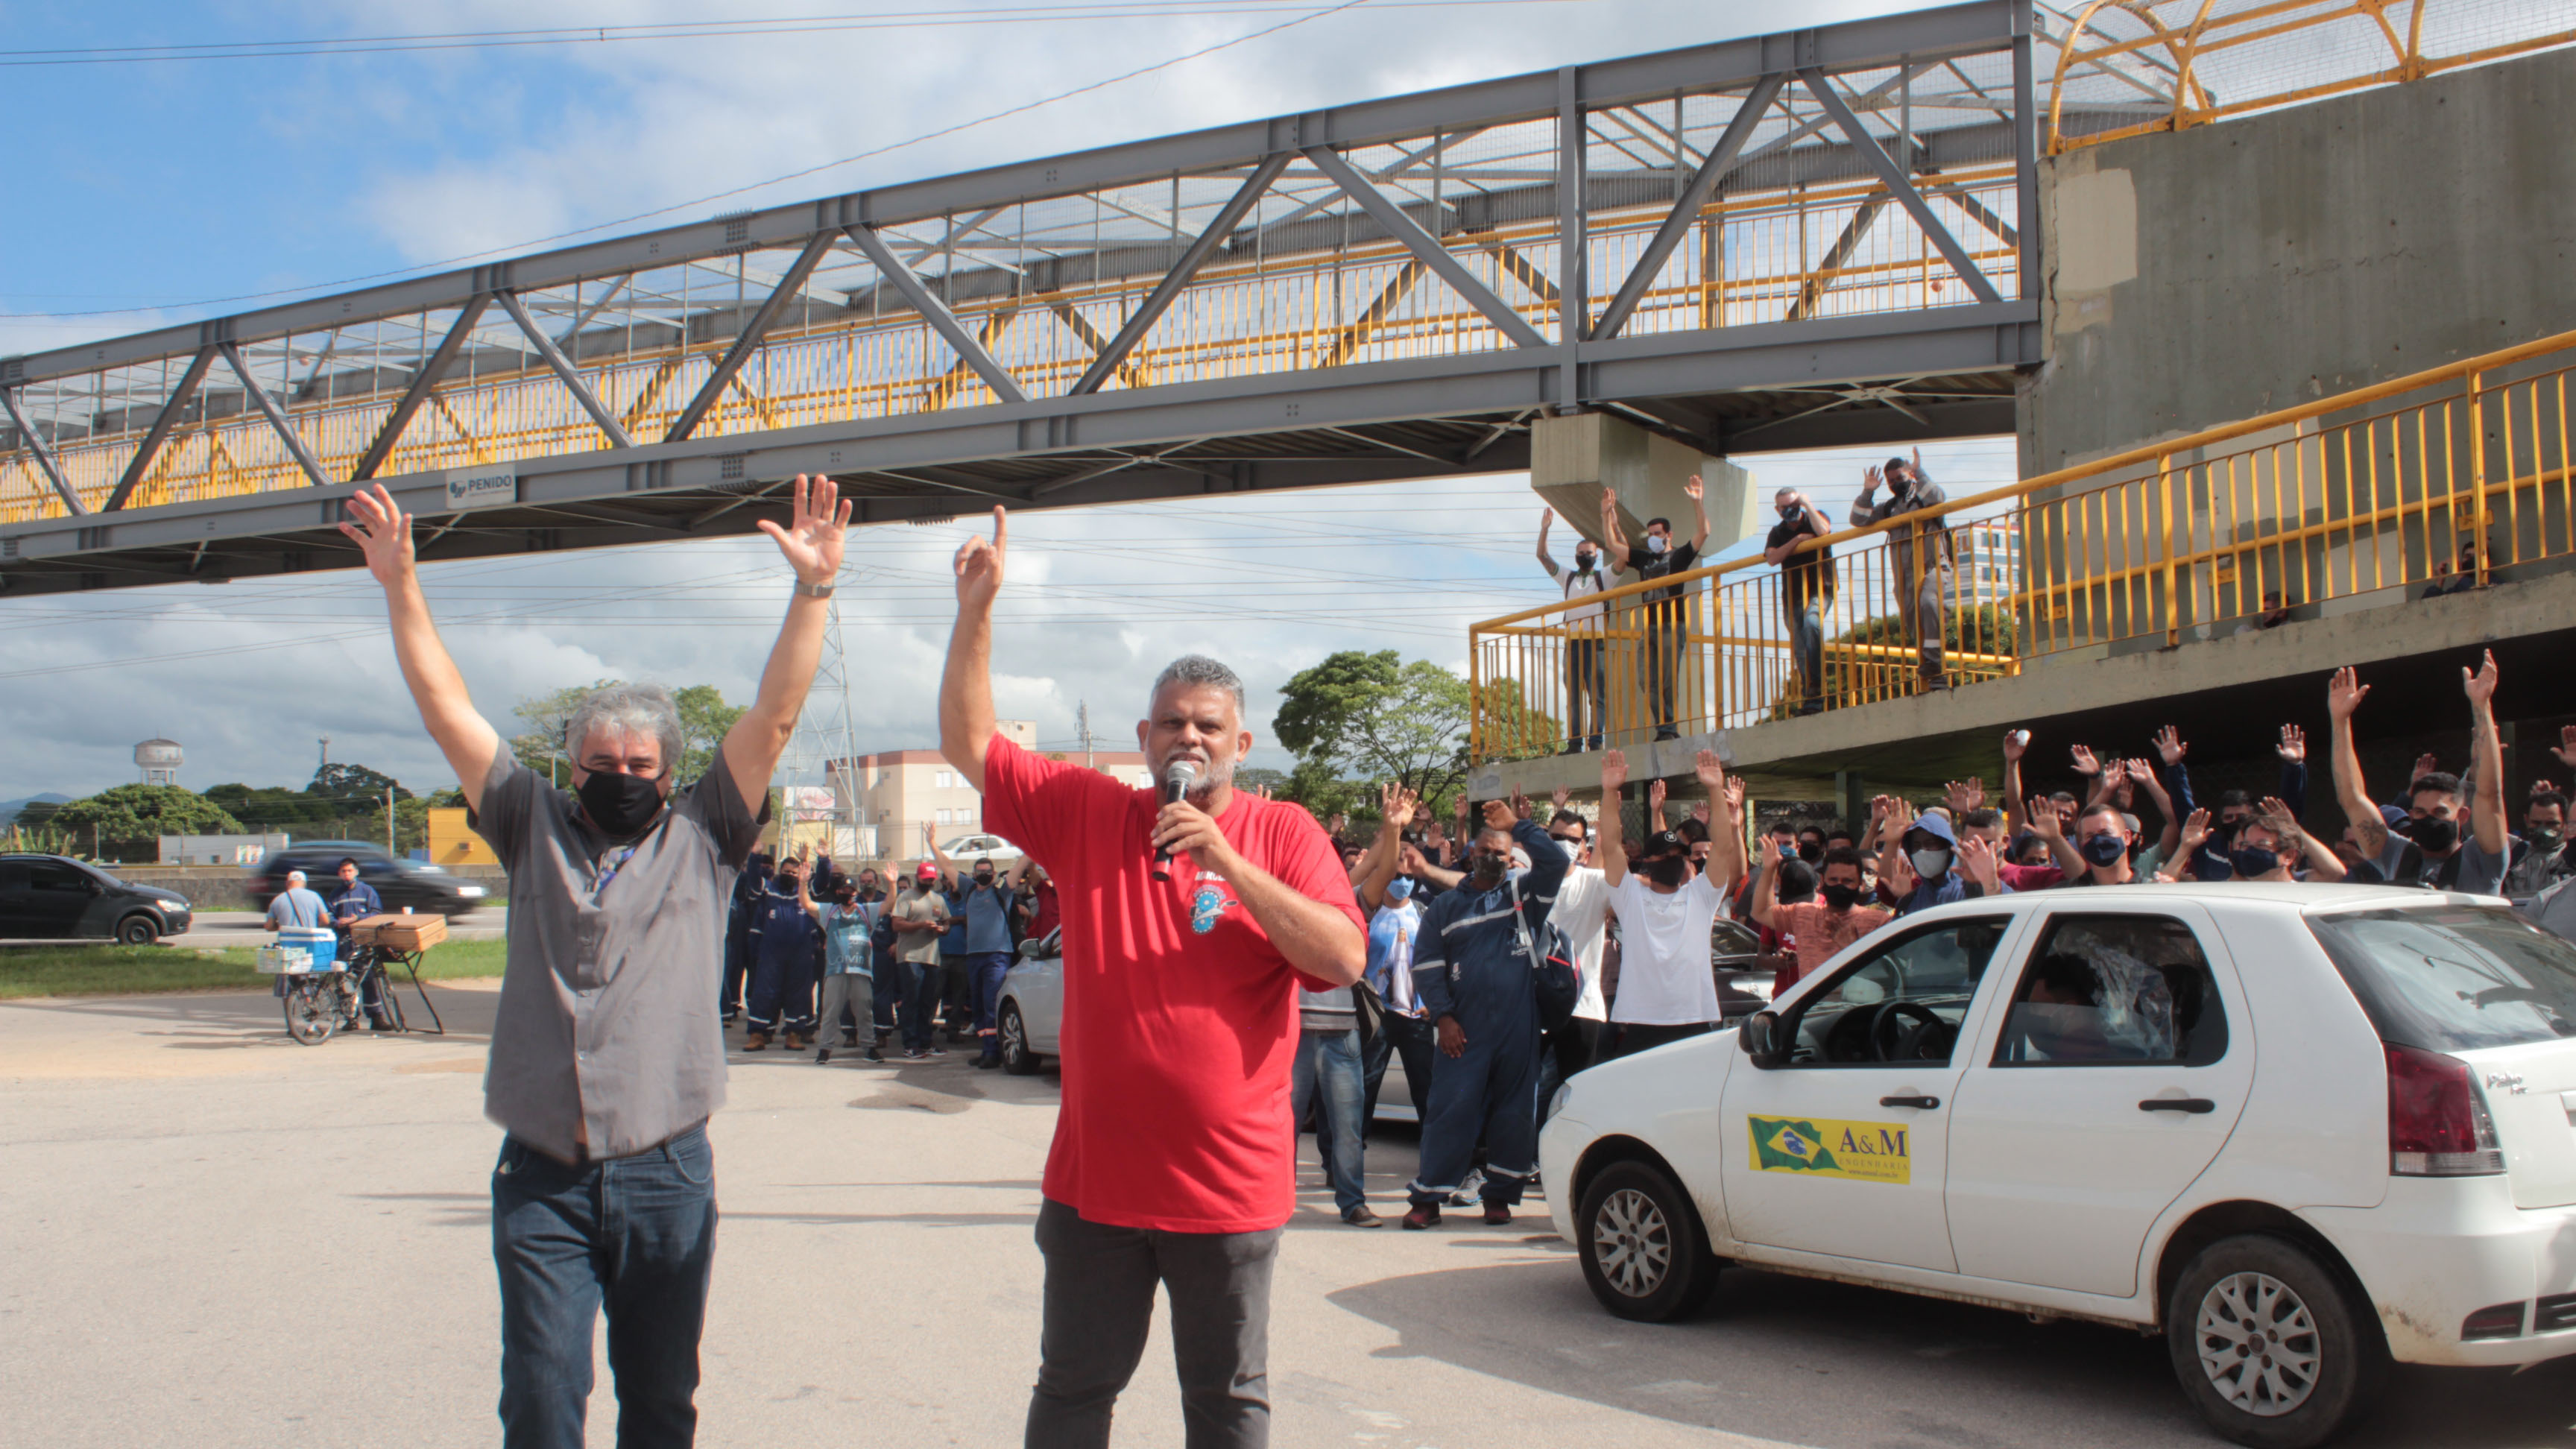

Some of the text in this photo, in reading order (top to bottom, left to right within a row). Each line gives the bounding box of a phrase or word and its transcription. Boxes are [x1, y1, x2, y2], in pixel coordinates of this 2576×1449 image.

[468, 475, 512, 491] PENIDO
[1839, 1126, 1908, 1158] A&M
[1839, 1158, 1908, 1170] ENGENHARIA
